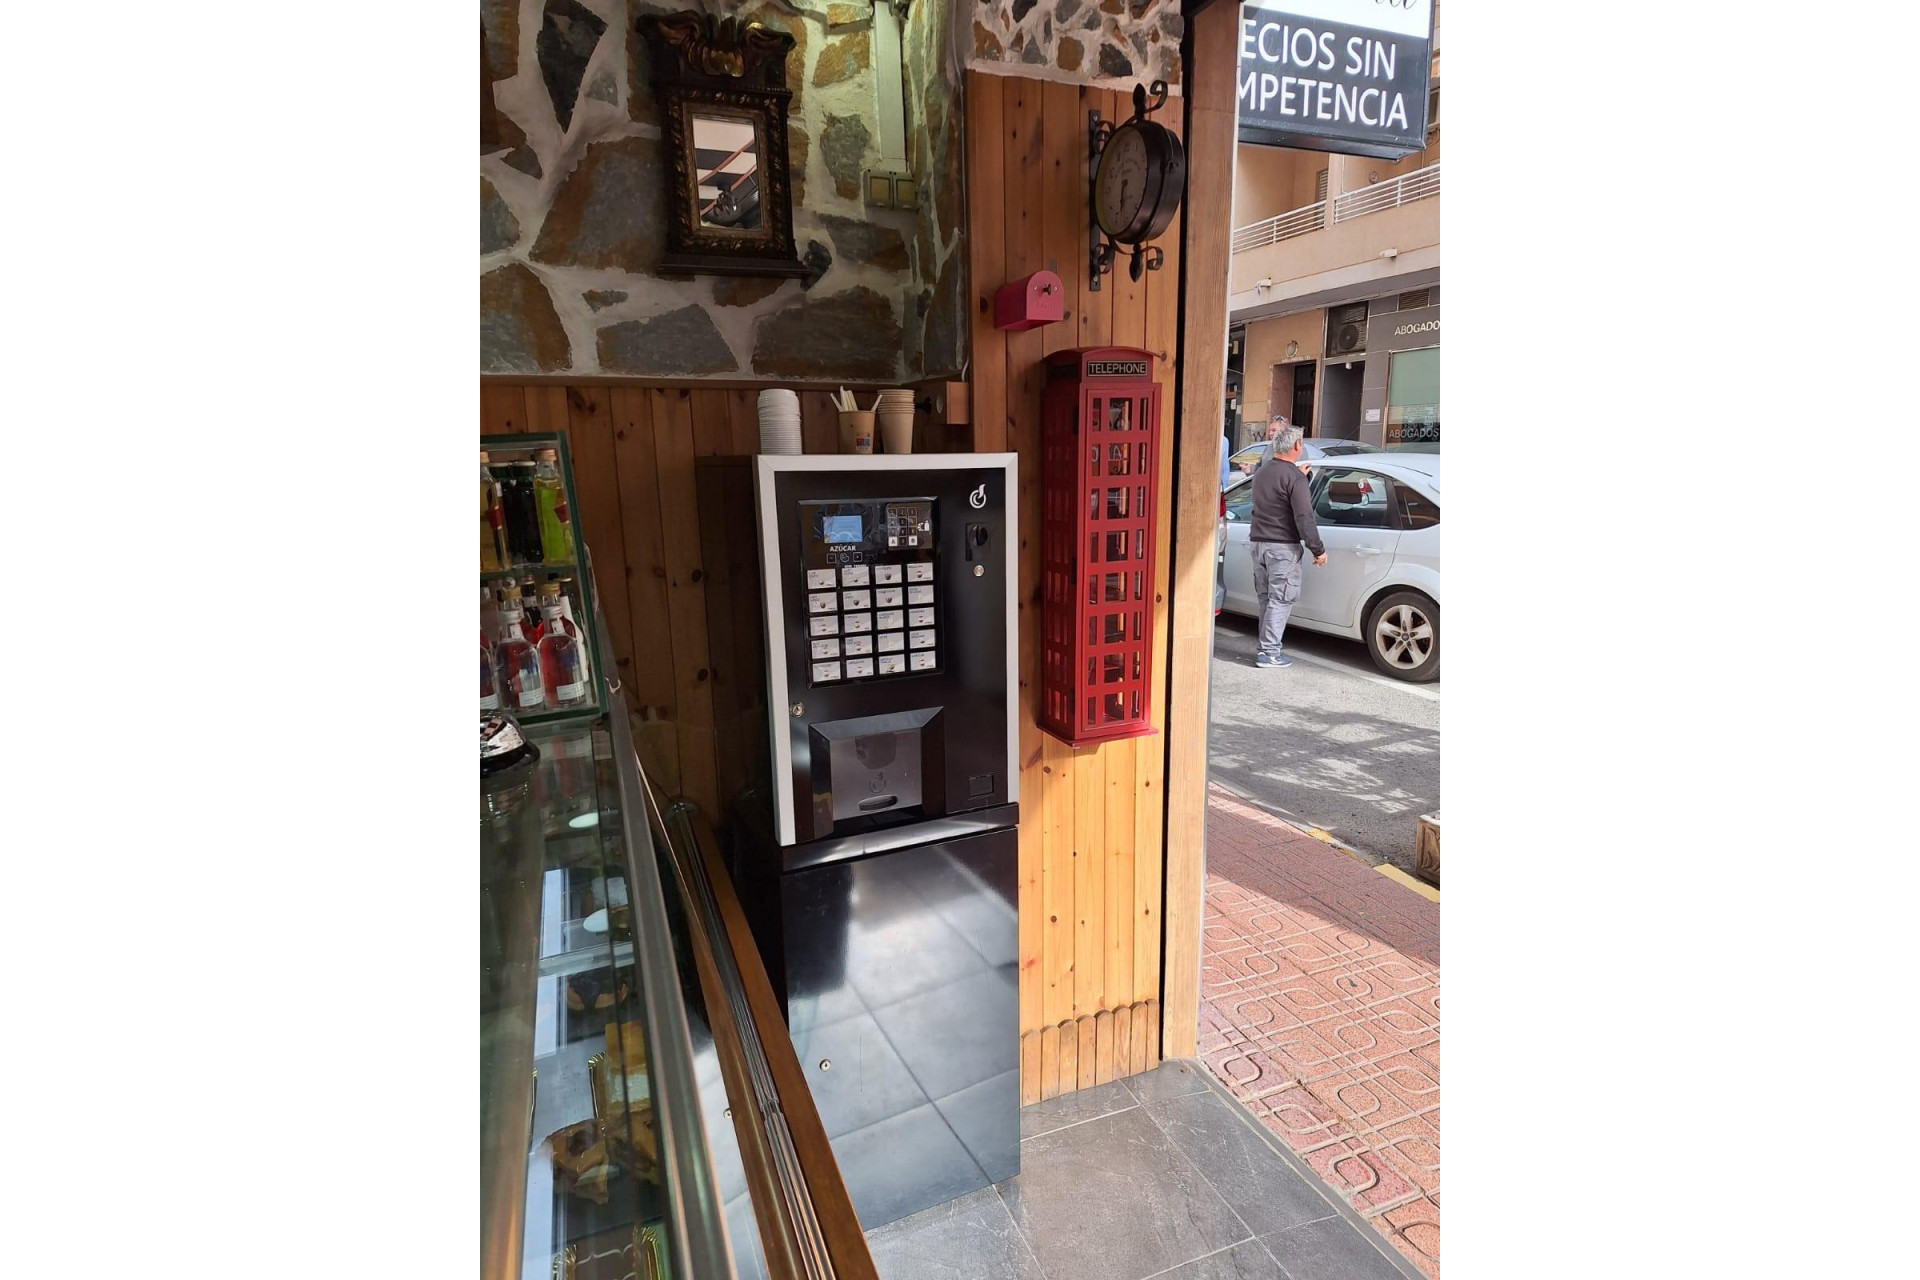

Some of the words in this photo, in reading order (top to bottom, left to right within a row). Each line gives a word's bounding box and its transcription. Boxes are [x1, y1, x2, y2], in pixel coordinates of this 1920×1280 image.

[1345, 36, 1396, 80] SIN
[1089, 363, 1146, 374] TELEPHONE
[1388, 427, 1440, 439] ABOGADOS
[829, 544, 857, 552] AZÚCAR
